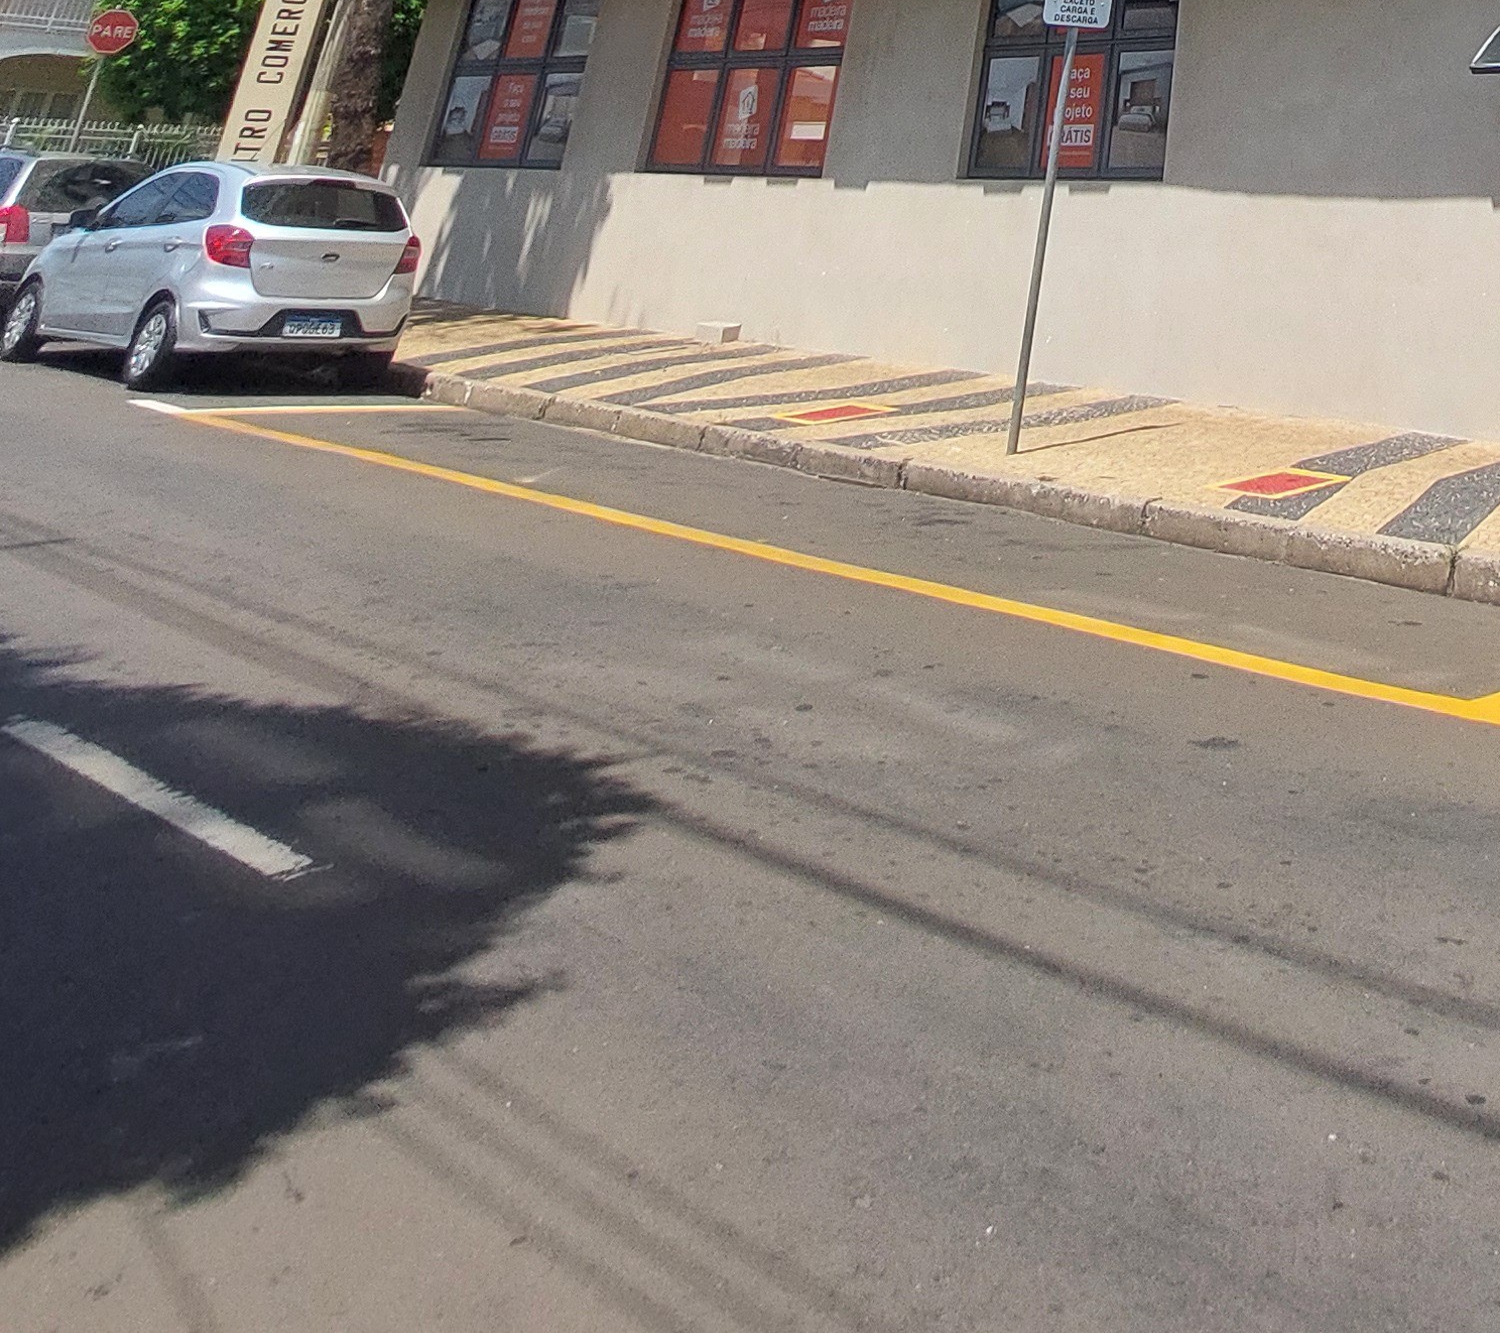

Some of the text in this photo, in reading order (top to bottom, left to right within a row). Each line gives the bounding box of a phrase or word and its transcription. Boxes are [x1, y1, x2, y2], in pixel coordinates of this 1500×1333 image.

[810, 3, 847, 18] madeira
[1060, 4, 1096, 15] CARGA E
[808, 17, 845, 32] madeira
[1054, 14, 1099, 25] DESCARGA
[91, 23, 135, 40] PARE
[1069, 67, 1091, 83] aça
[1069, 87, 1090, 99] seu
[1064, 103, 1093, 121] ojeto
[231, 109, 272, 162] TRO
